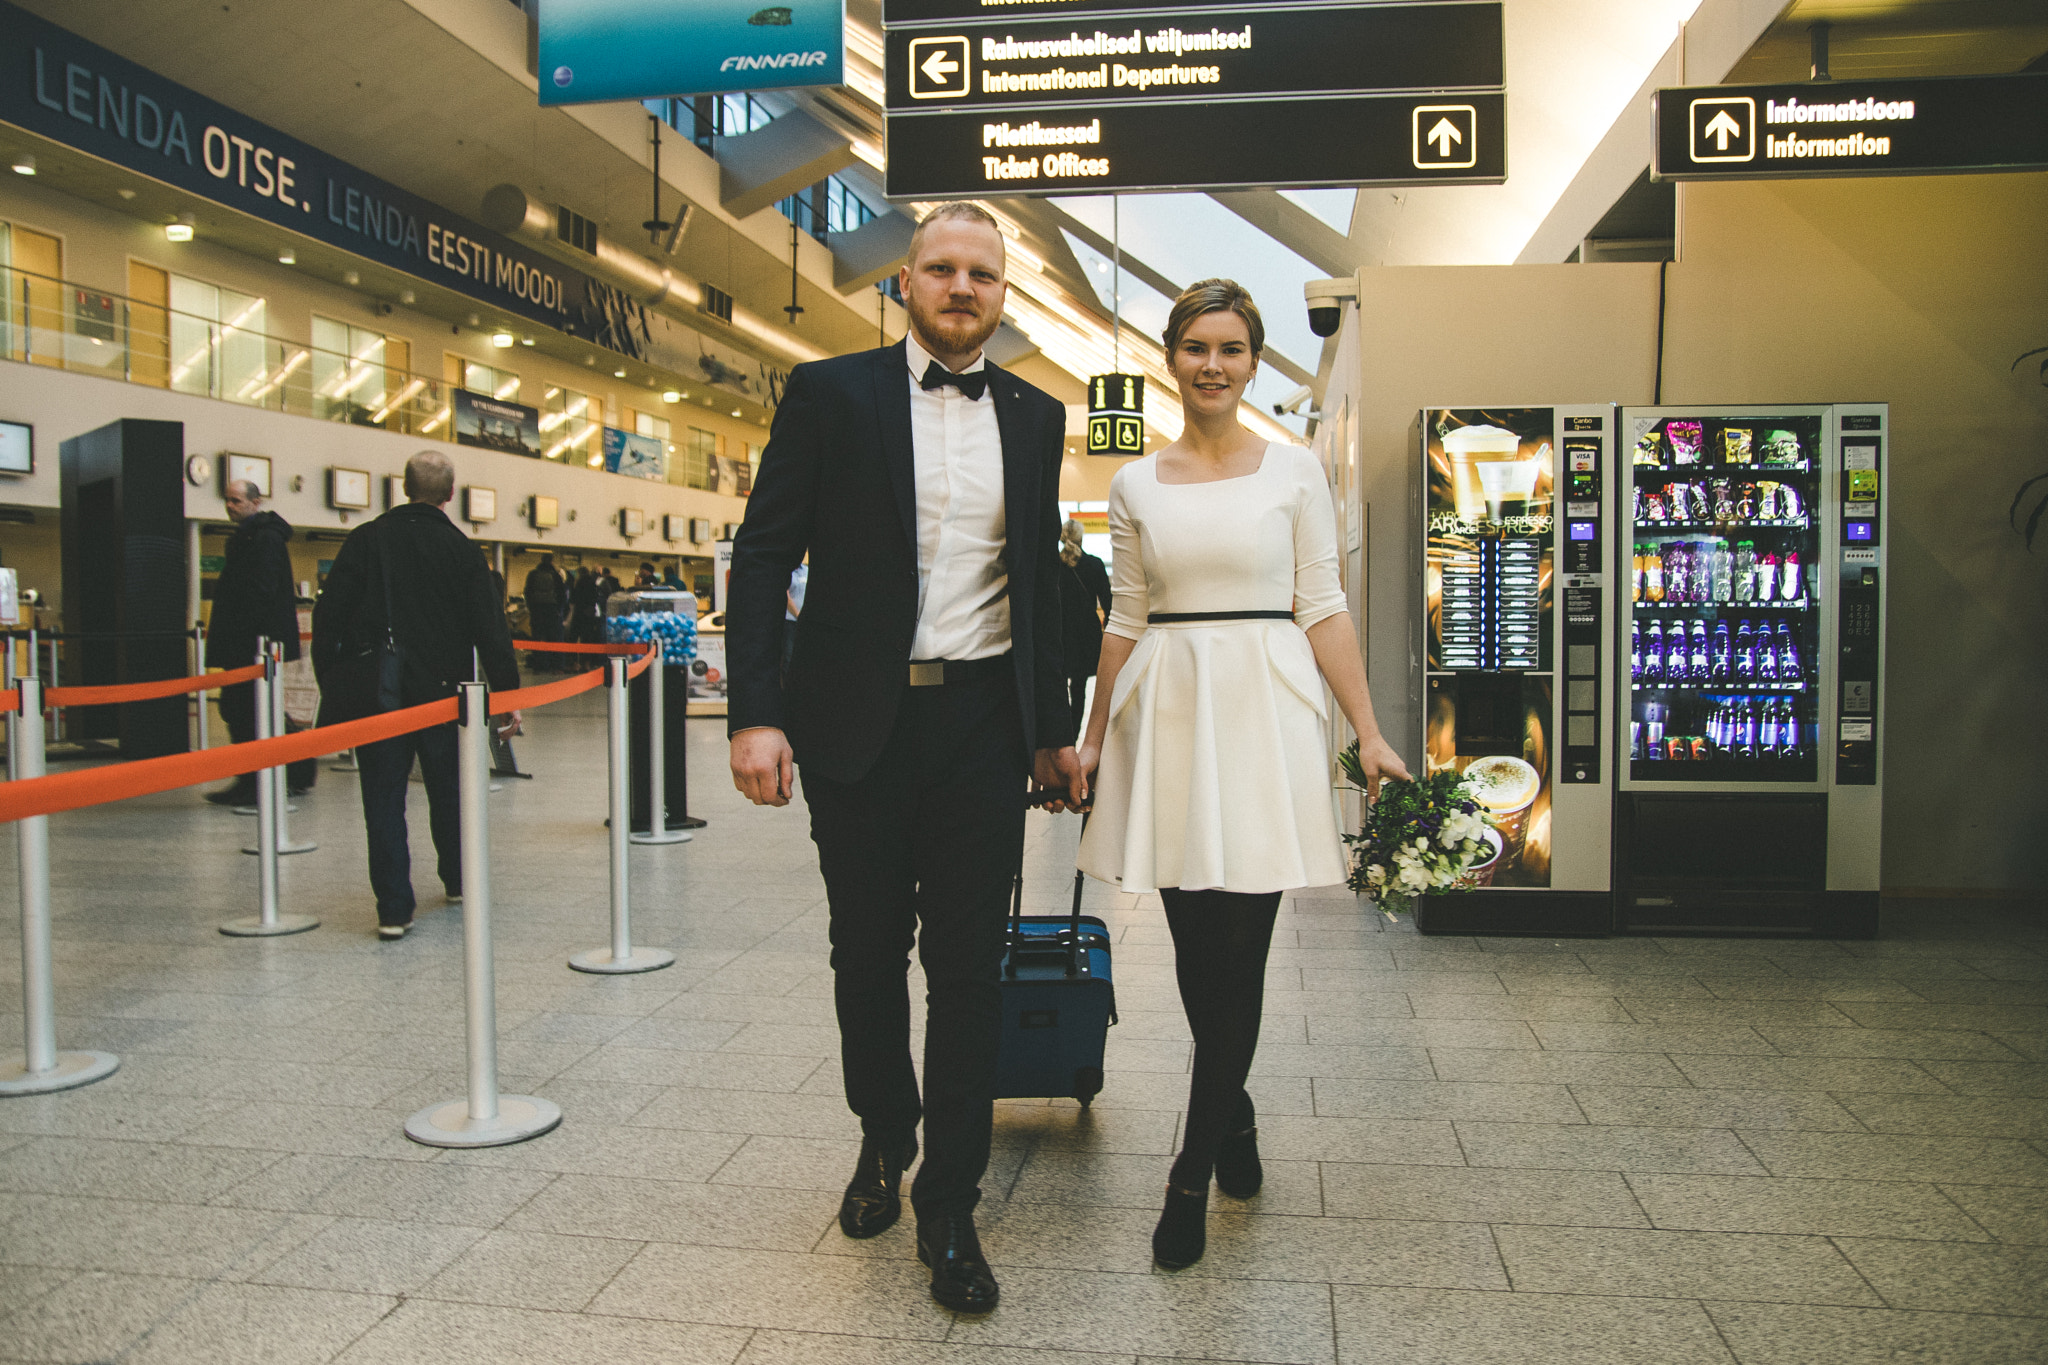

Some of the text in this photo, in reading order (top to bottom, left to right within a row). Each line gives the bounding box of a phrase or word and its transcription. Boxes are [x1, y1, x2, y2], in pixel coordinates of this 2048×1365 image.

[982, 25, 1251, 60] Rahvusvahelised väljumised
[720, 51, 827, 72] FINNAIR
[983, 63, 1220, 92] International Departures
[1766, 97, 1914, 123] Informatsioon
[982, 119, 1100, 147] Piletikassad
[1766, 132, 1890, 158] Information
[983, 152, 1109, 180] Ticket Offices
[35, 47, 567, 315] LENDA OTSE. LENDA EESTI MOODI.
[1504, 515, 1554, 525] ESPRESSO
